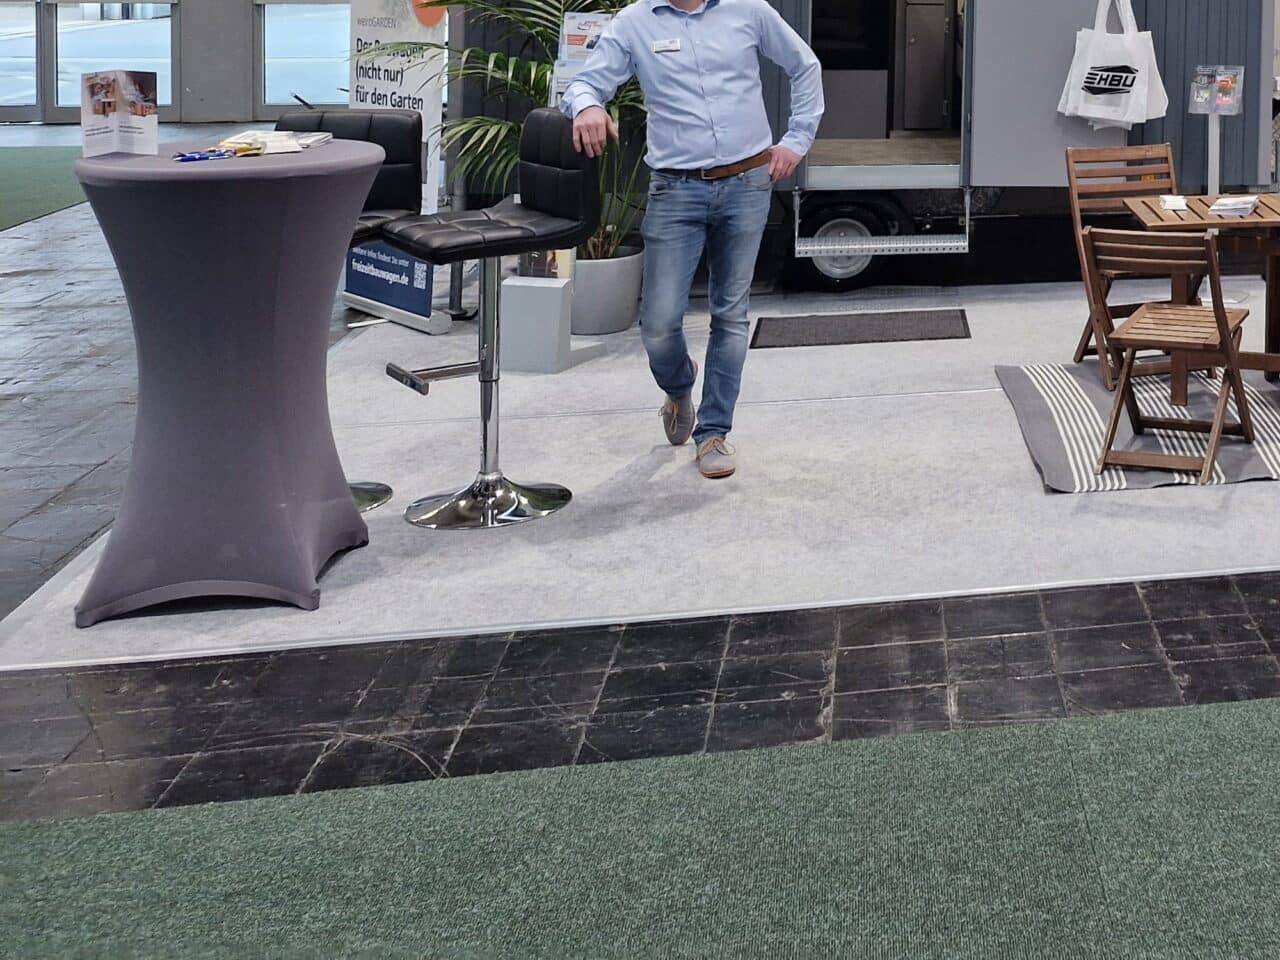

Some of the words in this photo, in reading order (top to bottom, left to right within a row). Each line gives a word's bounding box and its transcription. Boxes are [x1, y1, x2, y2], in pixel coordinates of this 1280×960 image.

[356, 59, 381, 82] (nicht
[383, 67, 404, 88] nur)
[355, 84, 368, 103] für
[370, 88, 388, 106] den
[390, 91, 424, 111] Garten
